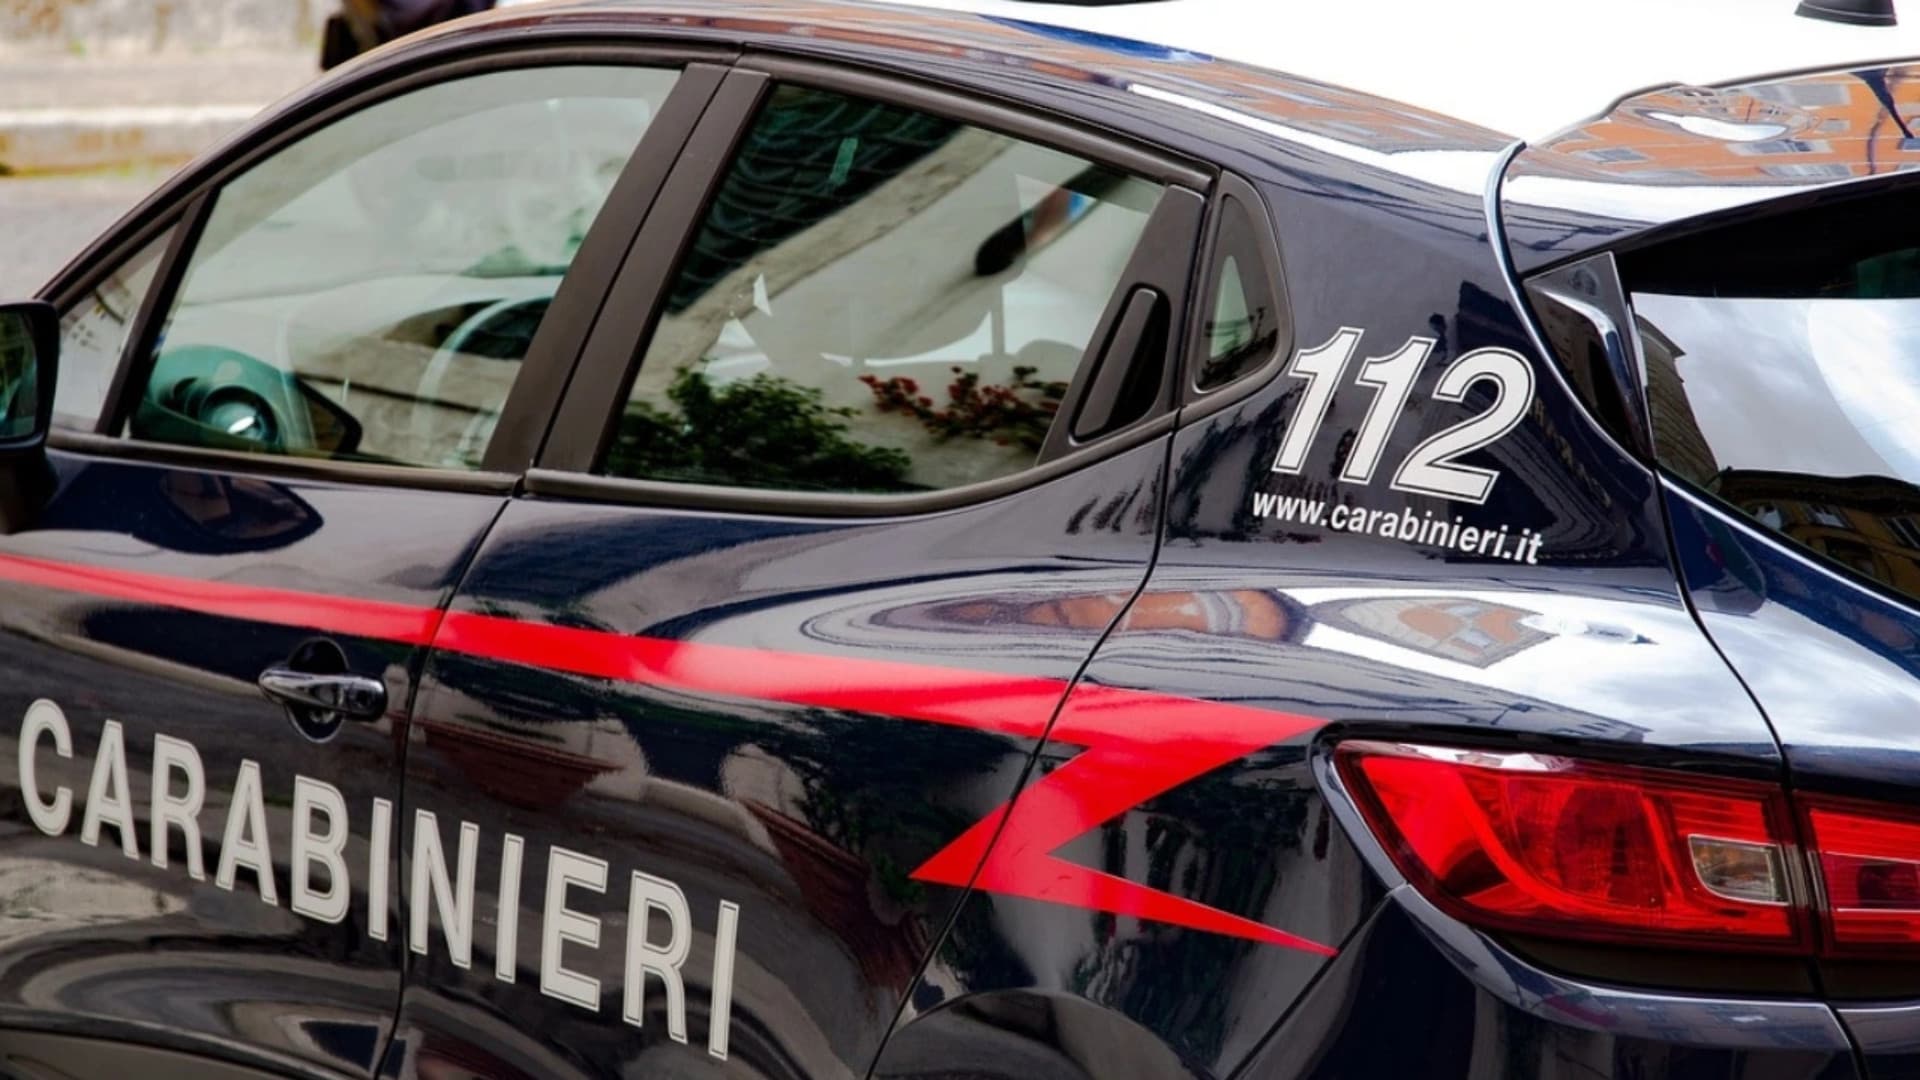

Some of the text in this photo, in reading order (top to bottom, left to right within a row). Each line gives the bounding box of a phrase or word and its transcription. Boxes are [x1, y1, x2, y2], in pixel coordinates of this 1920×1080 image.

[1271, 326, 1536, 505] 112
[1253, 492, 1543, 565] www.carabinieri.it
[18, 698, 740, 1060] CARABINIERI
